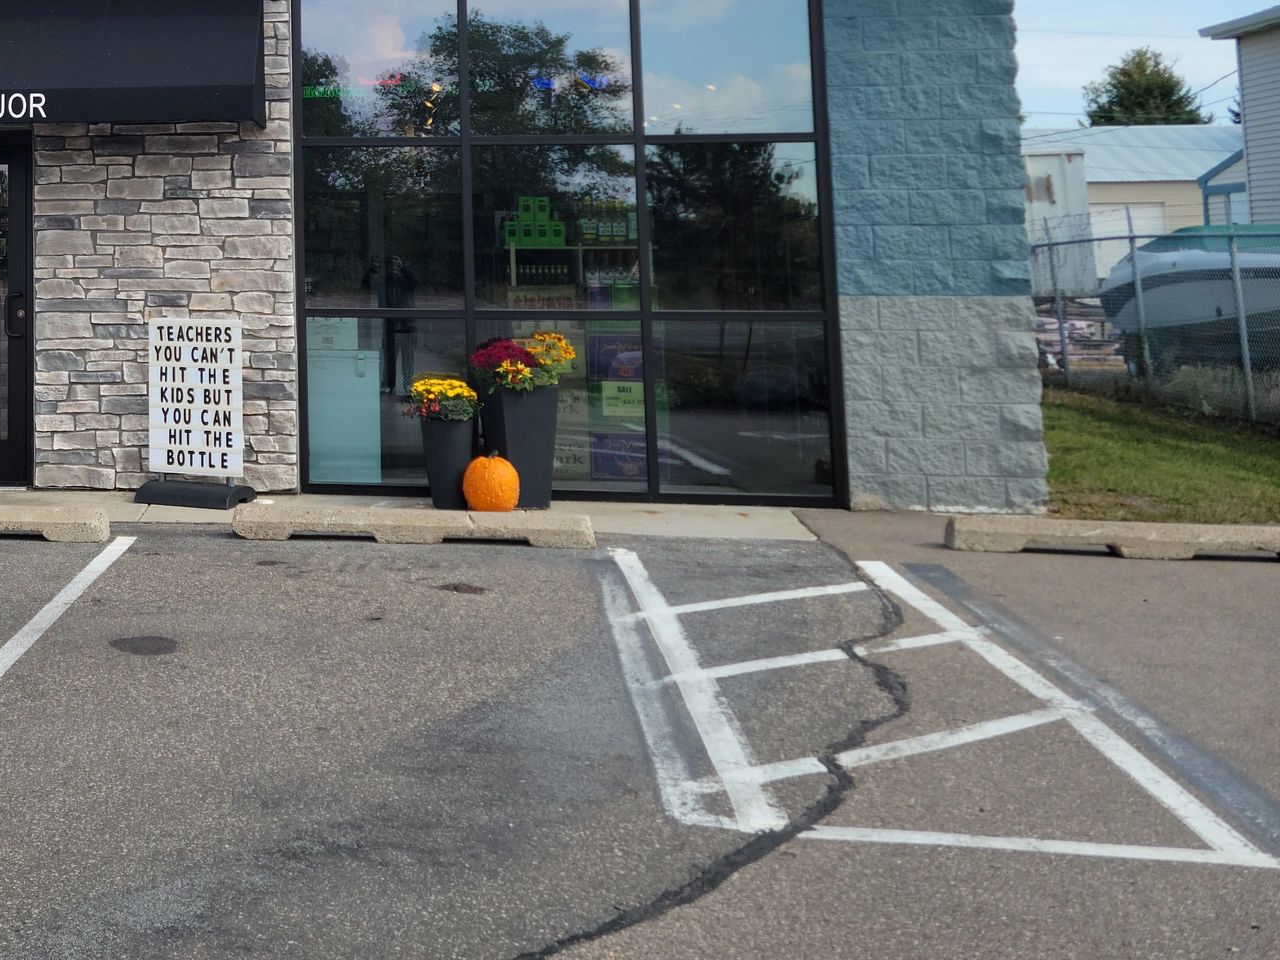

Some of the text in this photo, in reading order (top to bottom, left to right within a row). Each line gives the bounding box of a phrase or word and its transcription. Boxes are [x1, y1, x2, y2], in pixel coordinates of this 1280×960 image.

[157, 325, 232, 343] TEACHERS
[154, 345, 235, 364] YOU CAN'T
[160, 366, 230, 385] HIT THE
[160, 387, 232, 406] KIDS BUT
[162, 407, 231, 427] YOU CAN
[168, 428, 233, 448] HIT THE
[166, 449, 228, 469] BOTTLE
